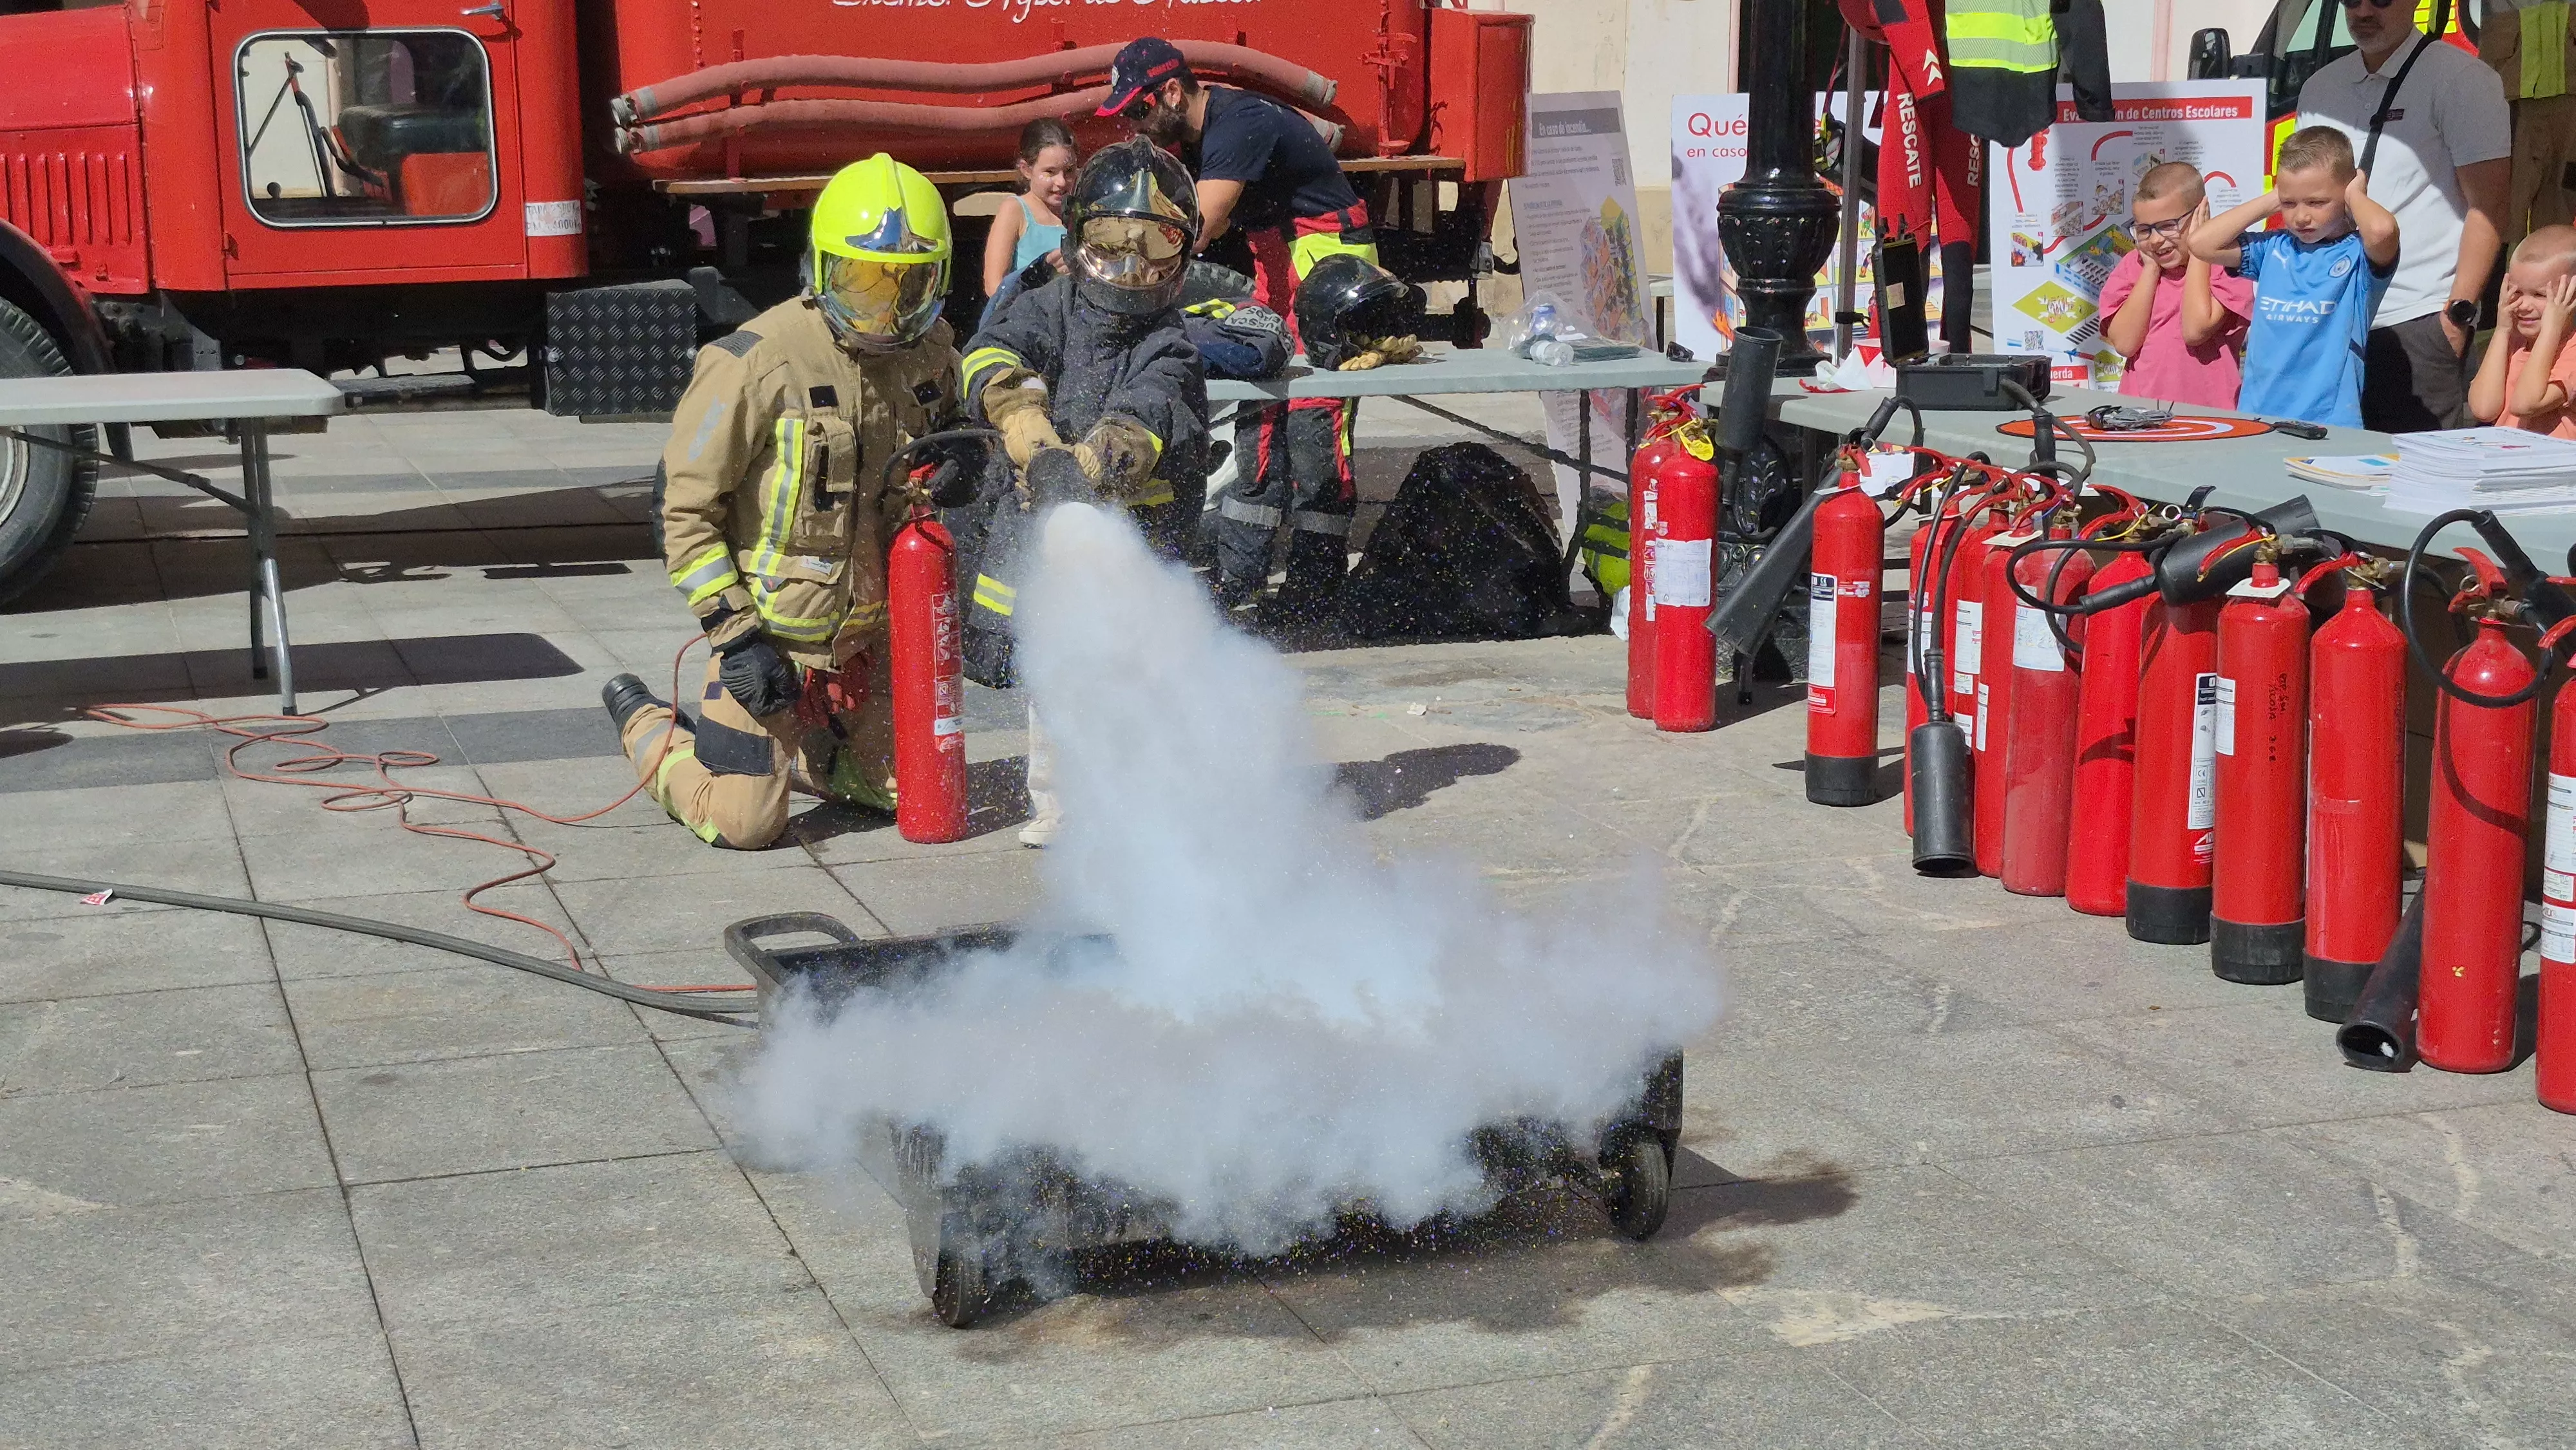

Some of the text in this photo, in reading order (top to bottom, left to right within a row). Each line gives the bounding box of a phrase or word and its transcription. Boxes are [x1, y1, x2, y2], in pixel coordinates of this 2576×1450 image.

[2126, 108, 2139, 120] de
[2141, 107, 2184, 120] Centros
[2185, 104, 2238, 118] Escolares
[1687, 112, 1747, 138] Qué
[1897, 91, 1922, 189] RESCATE
[1687, 147, 1748, 158] en caso
[2260, 296, 2338, 315] ETIHAD
[2266, 313, 2320, 324] AIRWAYS
